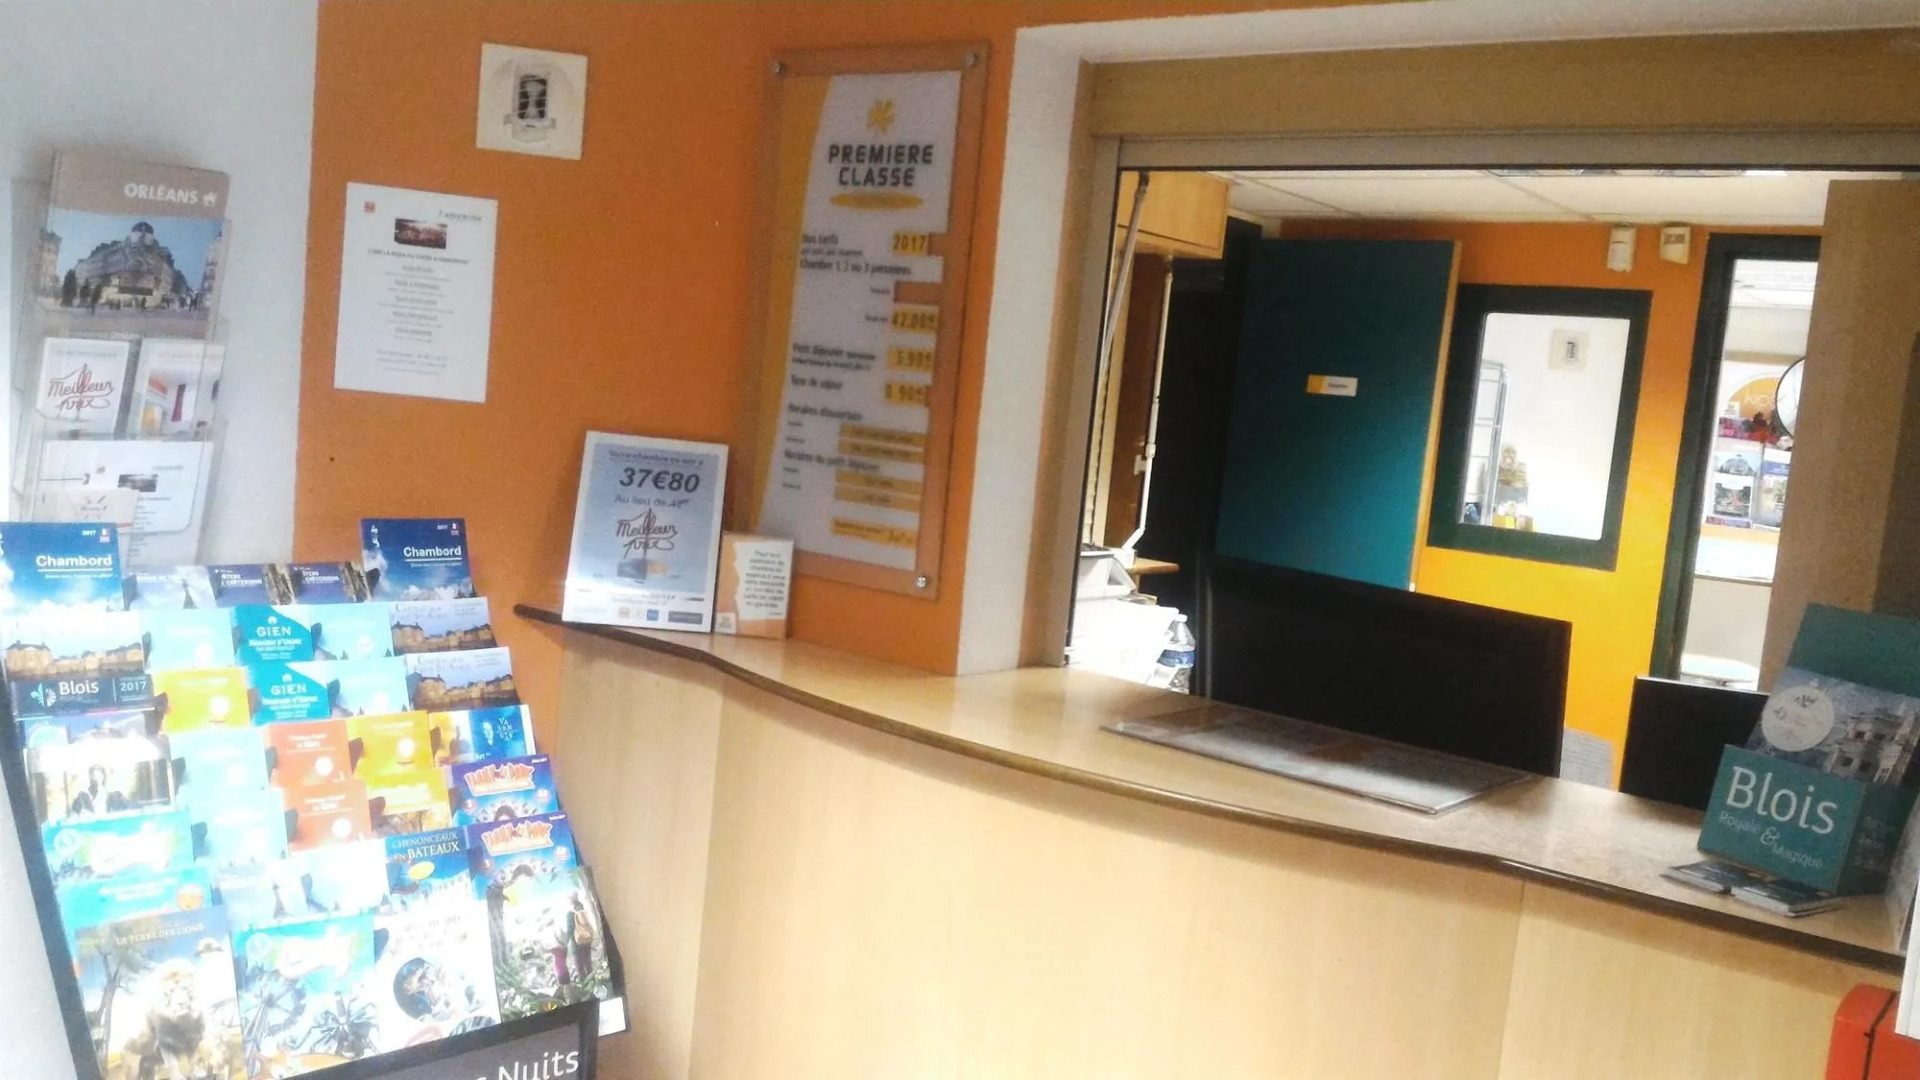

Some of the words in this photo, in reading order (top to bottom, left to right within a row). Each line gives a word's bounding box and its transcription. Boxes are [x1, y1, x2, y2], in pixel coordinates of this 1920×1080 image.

[828, 144, 934, 165] PREMIERE
[838, 166, 916, 187] CLASSE
[619, 466, 700, 493] 37€80
[36, 554, 113, 567] Chambord
[403, 545, 462, 557] Chambord
[256, 626, 292, 637] GIEN
[59, 680, 100, 695] Blois
[120, 680, 147, 692] 2017
[271, 683, 307, 696] GIEN
[1726, 766, 1839, 834] Blois
[1719, 812, 1763, 834] Royale
[1760, 827, 1781, 846] &
[408, 841, 461, 860] BATEAUX
[498, 1050, 580, 1080] Nuits
